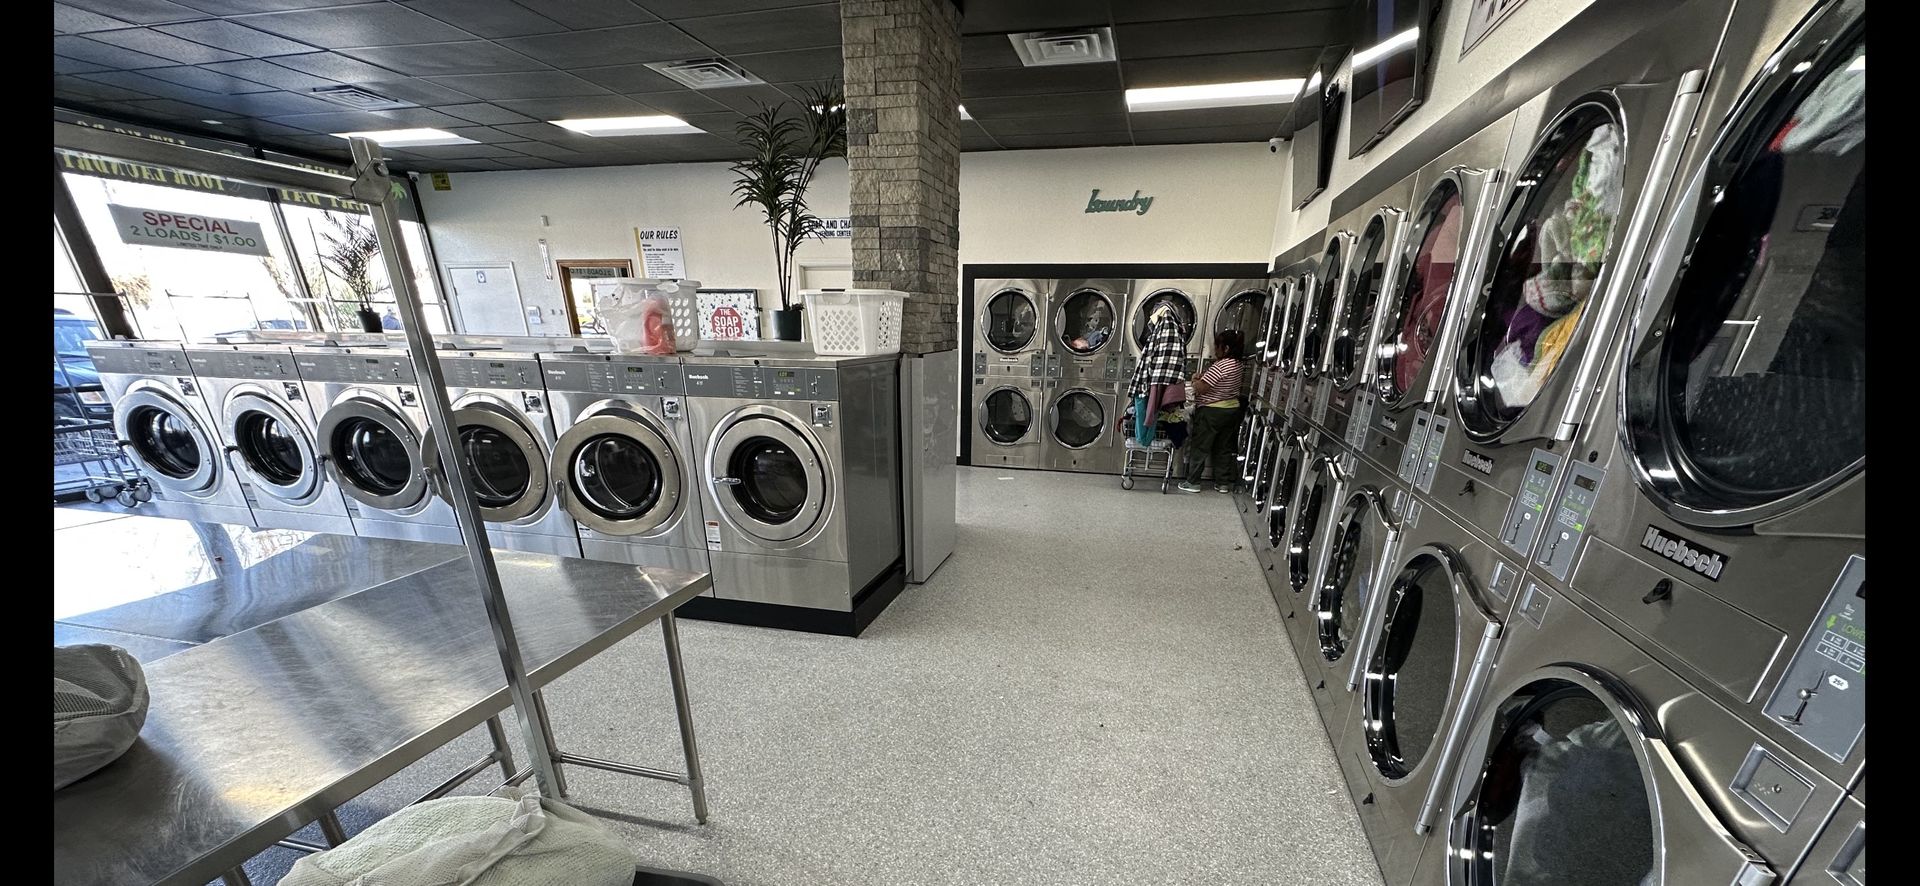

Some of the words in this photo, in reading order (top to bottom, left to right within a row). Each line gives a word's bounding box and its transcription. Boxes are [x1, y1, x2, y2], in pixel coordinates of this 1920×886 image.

[143, 211, 238, 235] SPECIAL
[826, 220, 837, 229] AND
[130, 225, 141, 236] 2
[144, 226, 202, 242] LOADS
[640, 230, 654, 240] OUR
[656, 229, 678, 240] RULES
[714, 316, 739, 327] SOAP
[715, 327, 740, 338] STOP
[1642, 526, 1723, 579] Huebsch
